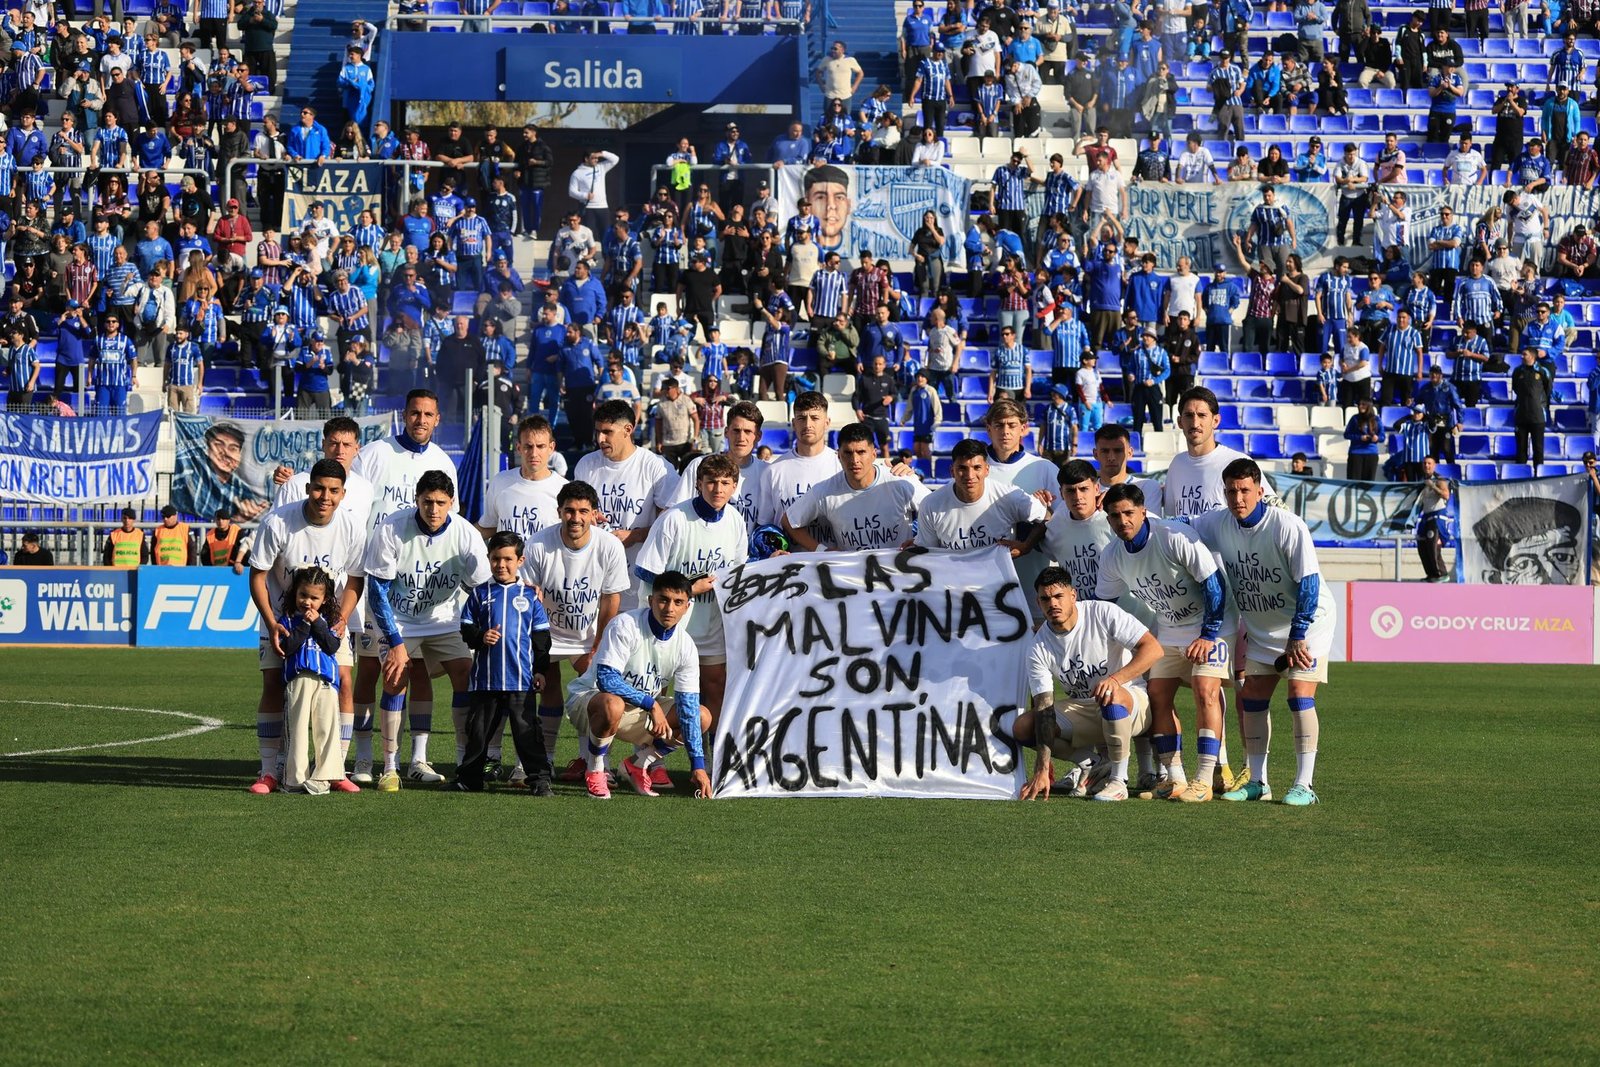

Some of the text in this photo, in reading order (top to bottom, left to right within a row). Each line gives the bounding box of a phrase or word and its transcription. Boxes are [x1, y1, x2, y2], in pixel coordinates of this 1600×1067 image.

[544, 60, 642, 89] Salida
[286, 166, 369, 193] PLAZA
[855, 167, 870, 199] TE
[1128, 187, 1219, 224] POR VERTE
[1124, 217, 1178, 239] VIVO
[29, 417, 141, 454] MALVINAS
[254, 426, 304, 464] COMO
[27, 459, 150, 498] ARGENTINAS
[602, 483, 626, 496] LAS
[796, 483, 812, 495] LA
[1182, 485, 1202, 499] LAS
[513, 505, 538, 520] LAS
[597, 496, 644, 515] ALVINAS
[854, 514, 881, 530] LAS
[841, 524, 899, 547] MALVINAS
[958, 525, 986, 539] LAS
[698, 547, 722, 561] LAS
[1074, 543, 1097, 557] LAS
[1238, 551, 1260, 566] LAS
[416, 560, 441, 573] LAS
[816, 546, 933, 599] LAS
[1065, 559, 1100, 576] MALVIN
[1225, 561, 1281, 584] MALVINAS
[38, 580, 115, 599] PINTÁ CON
[397, 572, 460, 590] MALVINAS
[563, 577, 589, 591] LAS
[1076, 575, 1097, 587] SON
[1136, 573, 1162, 588] LAS
[1239, 580, 1260, 592] SON
[407, 589, 434, 600] SON
[543, 587, 599, 605] MALVINA
[38, 593, 132, 632] WALL!
[144, 584, 260, 632] FIU
[556, 604, 584, 614] SON
[746, 582, 1028, 671] MALVINAS
[1411, 616, 1575, 632] GODOY CRUZ MZA
[1208, 642, 1227, 663] 20
[1060, 654, 1084, 674] LAS
[800, 651, 921, 697] SON
